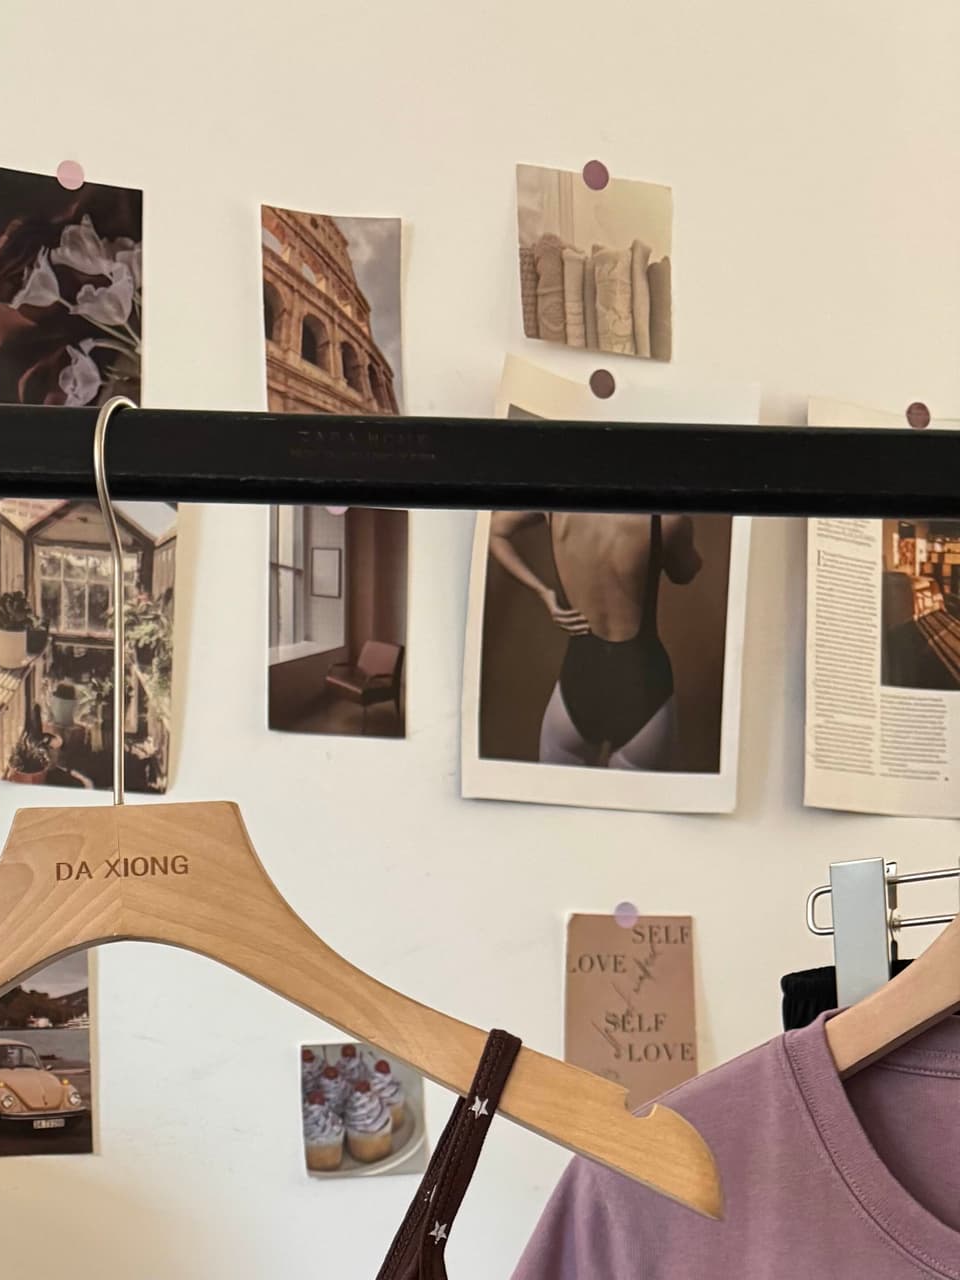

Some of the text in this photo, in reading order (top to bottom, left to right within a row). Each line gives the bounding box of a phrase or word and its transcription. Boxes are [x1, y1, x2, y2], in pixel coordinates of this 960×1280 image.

[55, 854, 190, 882] DA XIONG
[631, 923, 689, 946] SELF
[604, 1011, 667, 1033] SELF
[627, 1042, 696, 1064] LOVE
